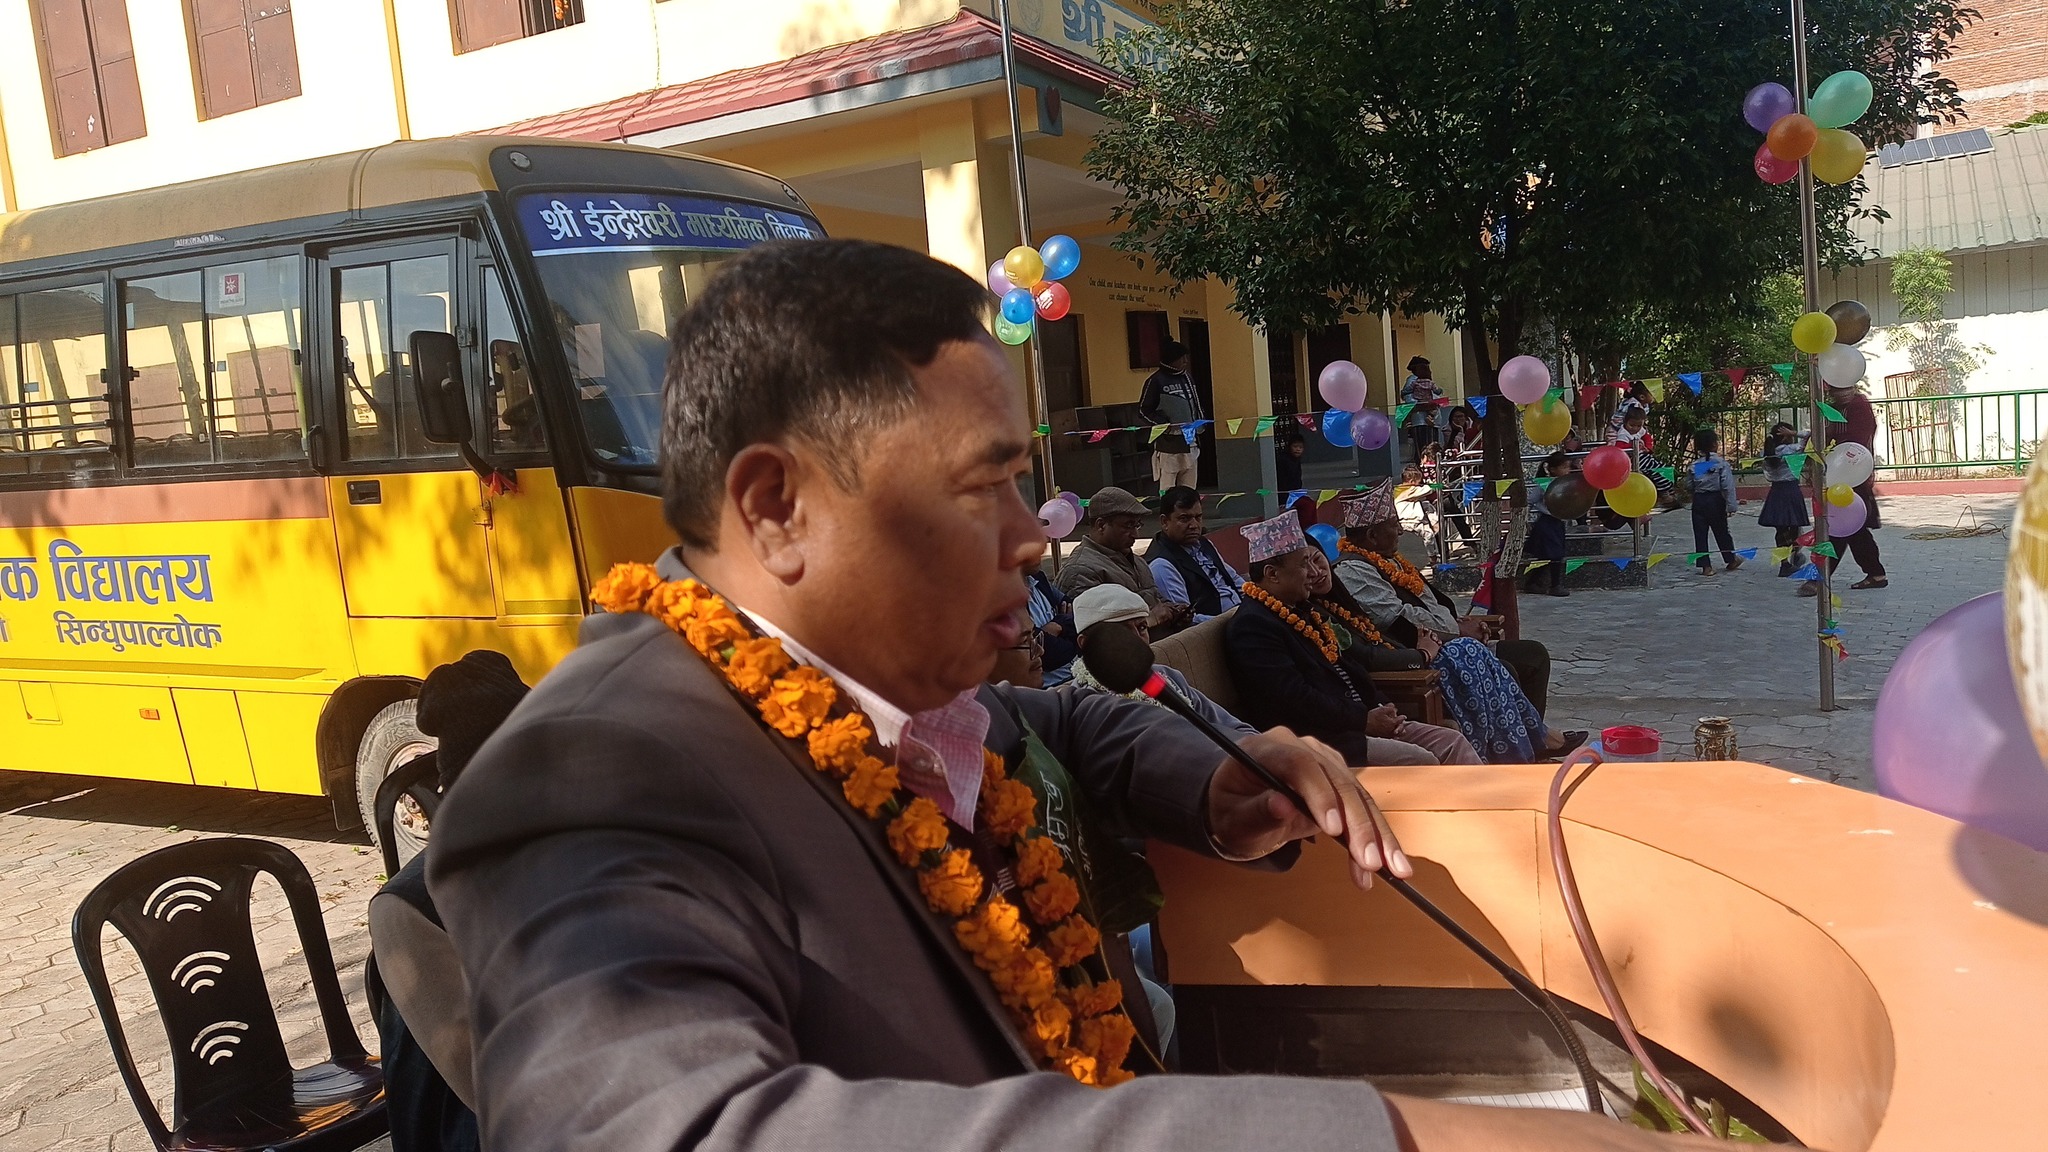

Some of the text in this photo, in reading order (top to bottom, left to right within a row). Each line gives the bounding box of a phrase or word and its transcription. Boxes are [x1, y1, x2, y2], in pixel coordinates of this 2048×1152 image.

[539, 200, 582, 241] श्री
[681, 207, 770, 242] माध्यमिक
[48, 538, 214, 605] विद्यालय
[53, 610, 222, 652] सिन्धुपाल्चोक
